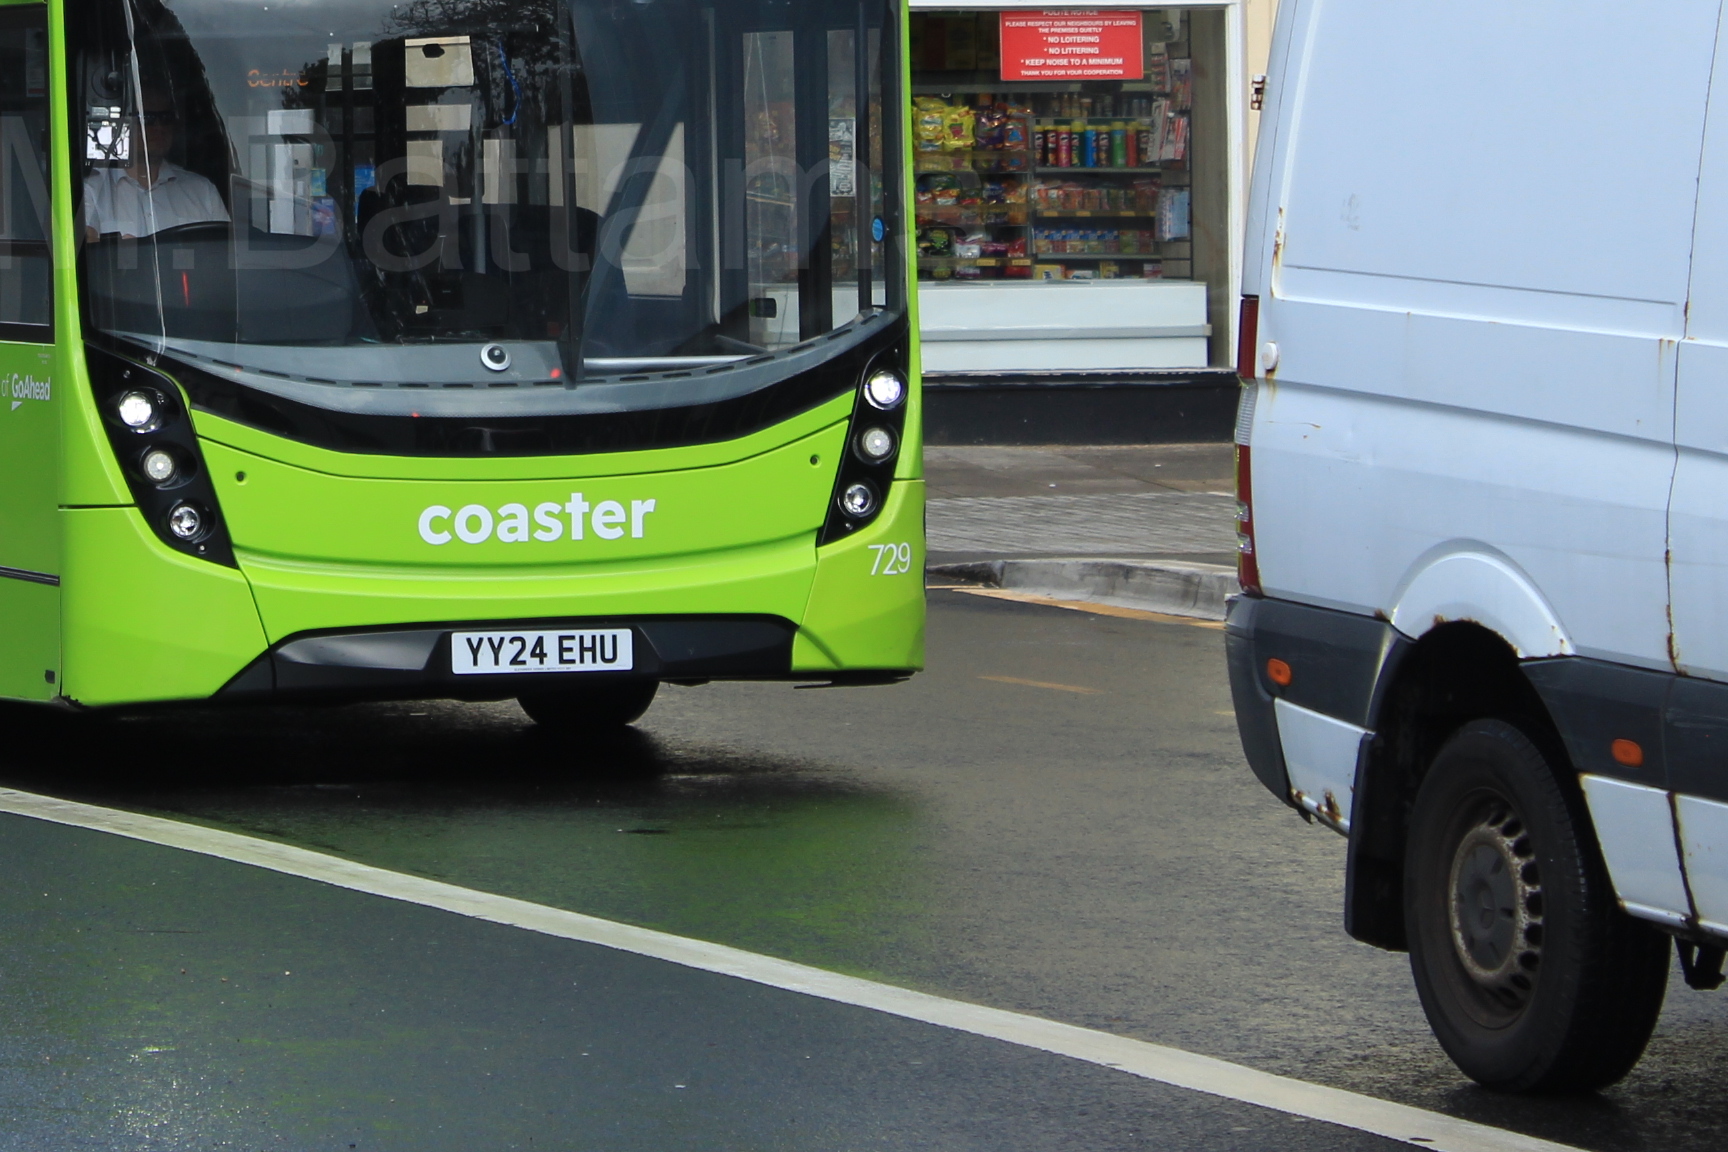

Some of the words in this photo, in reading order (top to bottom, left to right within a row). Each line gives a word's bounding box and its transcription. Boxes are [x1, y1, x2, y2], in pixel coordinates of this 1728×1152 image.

[1025, 58, 1045, 66] KEEP
[1088, 57, 1124, 65] MINIMUM
[1, 373, 10, 397] of
[11, 373, 51, 401] GoAhead
[417, 492, 657, 546] coaster
[867, 541, 912, 576] 729
[465, 635, 548, 667] YY24
[557, 634, 618, 665] EHU
